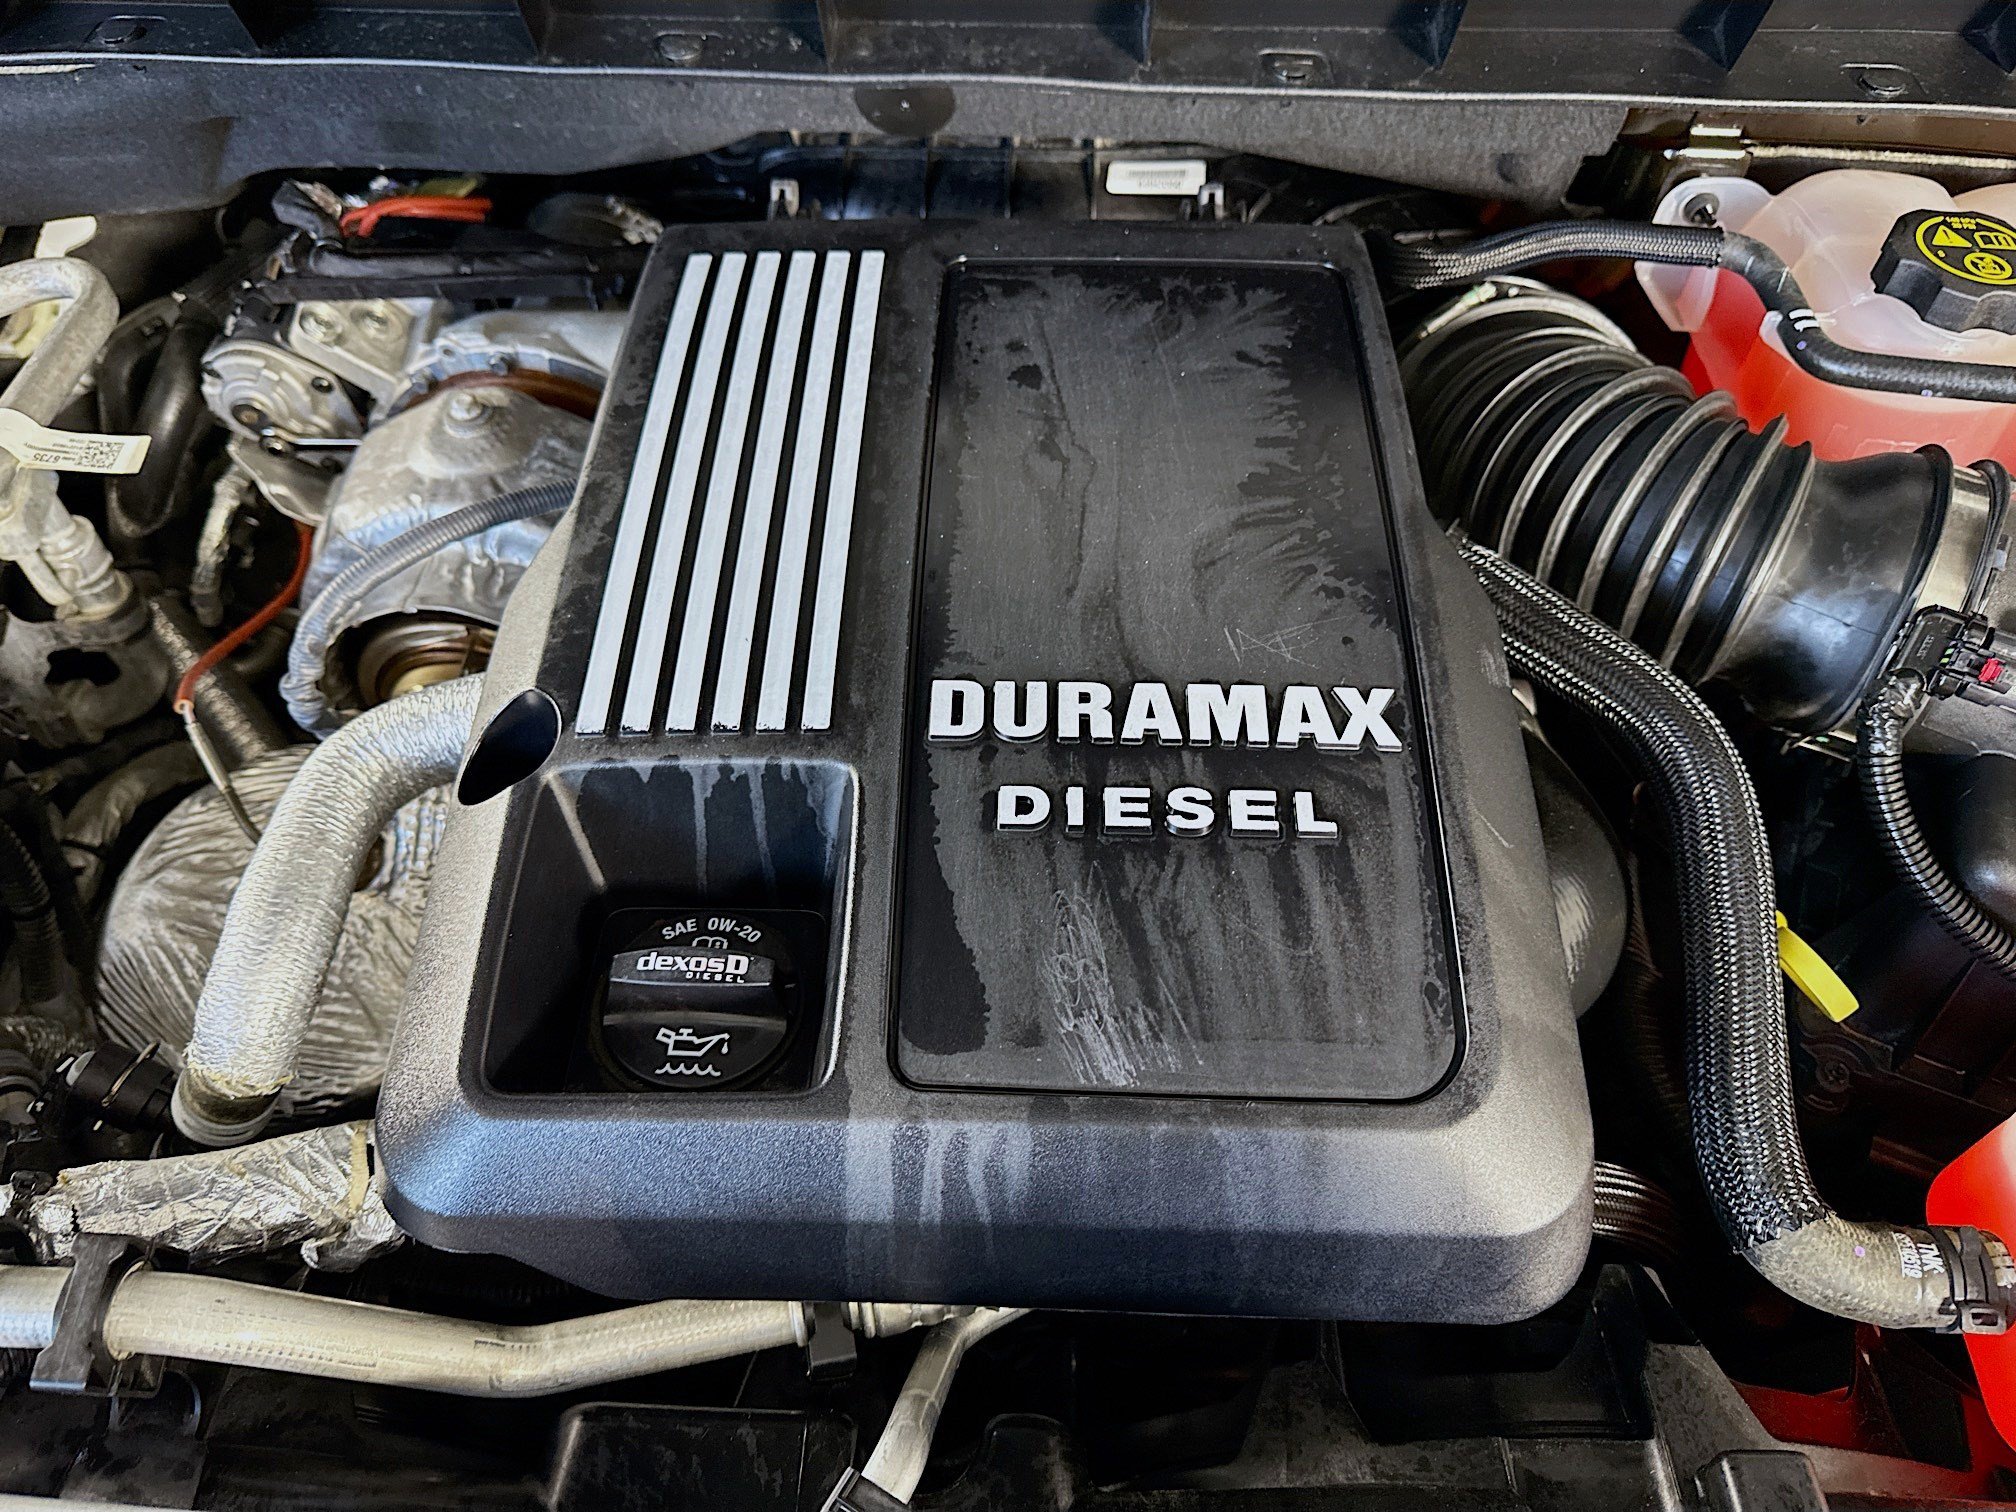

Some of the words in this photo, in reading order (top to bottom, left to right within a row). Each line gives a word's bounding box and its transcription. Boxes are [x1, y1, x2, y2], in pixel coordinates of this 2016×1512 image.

[928, 680, 1402, 751] DURAMAX
[997, 785, 1338, 839] DIESEL
[662, 918, 698, 940] SAE
[707, 917, 762, 943] 0W-20
[636, 952, 749, 975] dexosD
[686, 971, 745, 984] DIESEL
